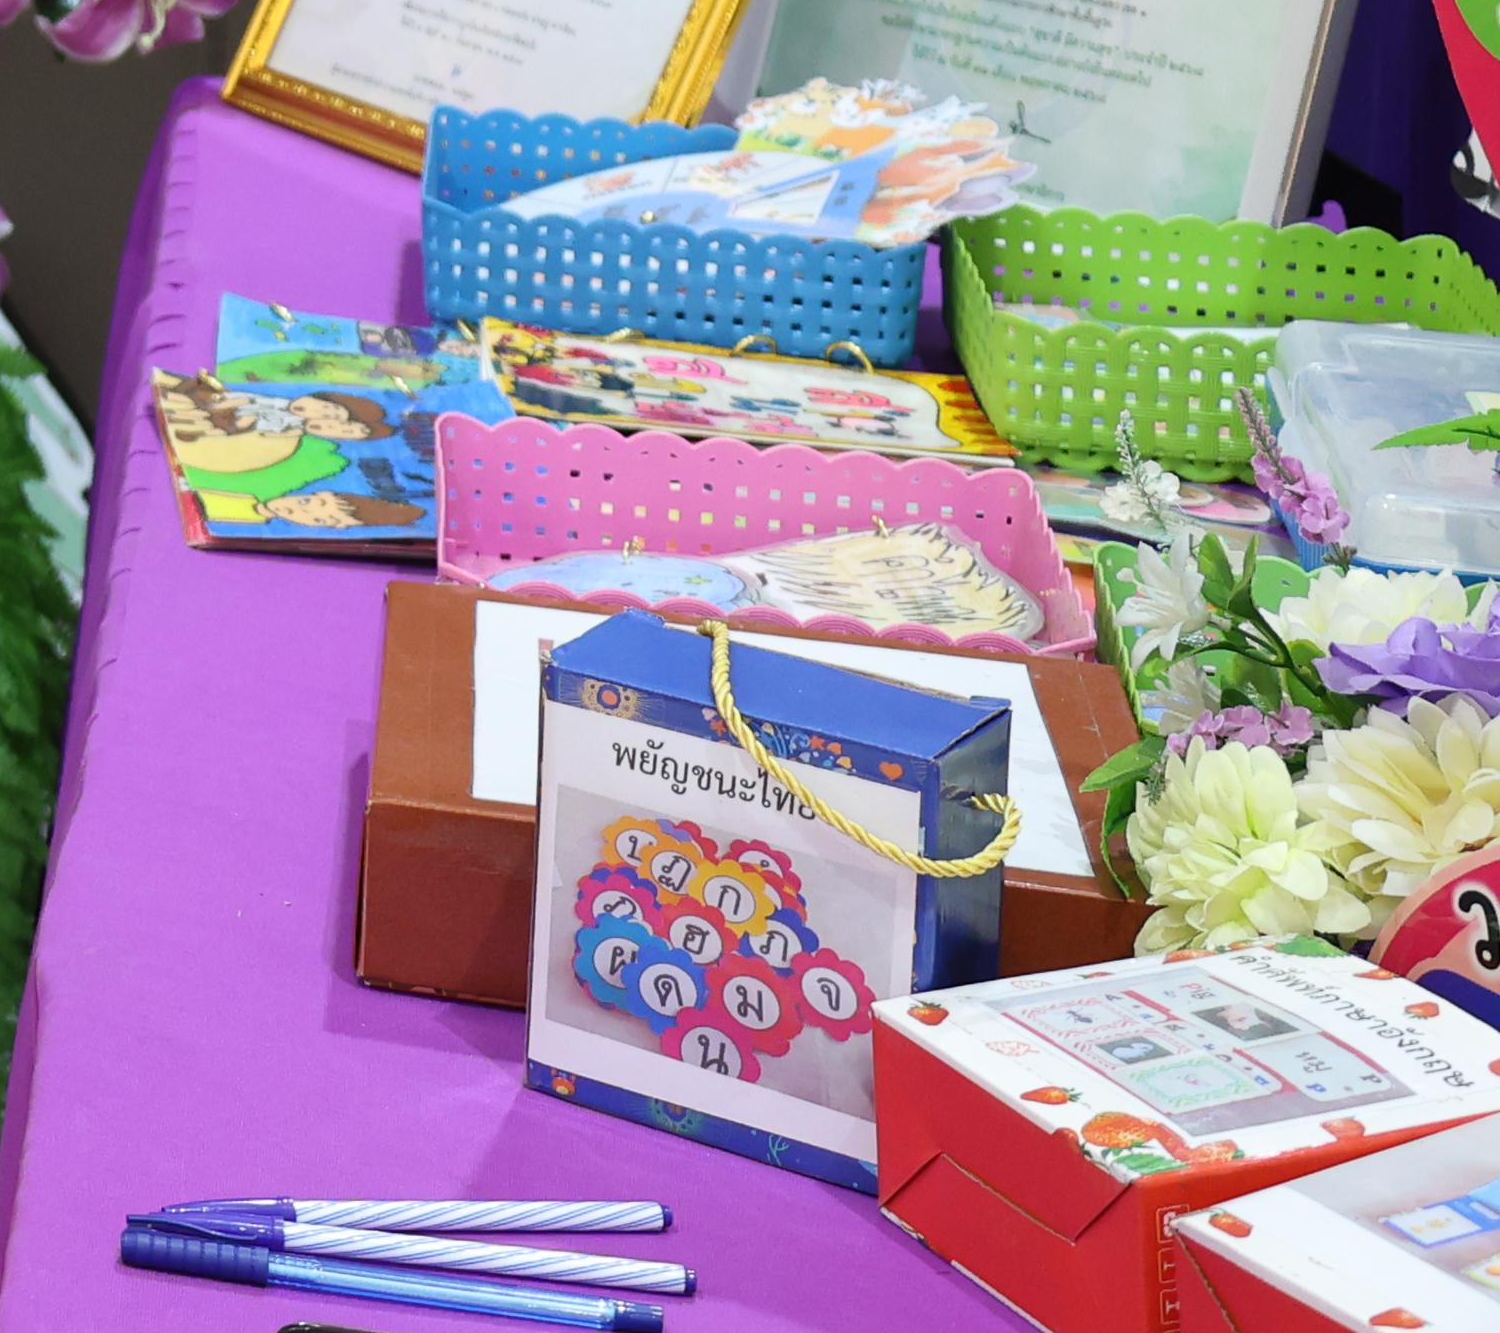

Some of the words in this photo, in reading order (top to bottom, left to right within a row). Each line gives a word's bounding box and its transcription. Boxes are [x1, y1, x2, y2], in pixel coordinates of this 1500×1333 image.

[612, 738, 816, 822] พยัญชนะไทย
[717, 884, 741, 916] ก
[735, 984, 765, 1023] ม
[1229, 951, 1476, 1091] คำศัพท์ภาษาอังกฤษ
